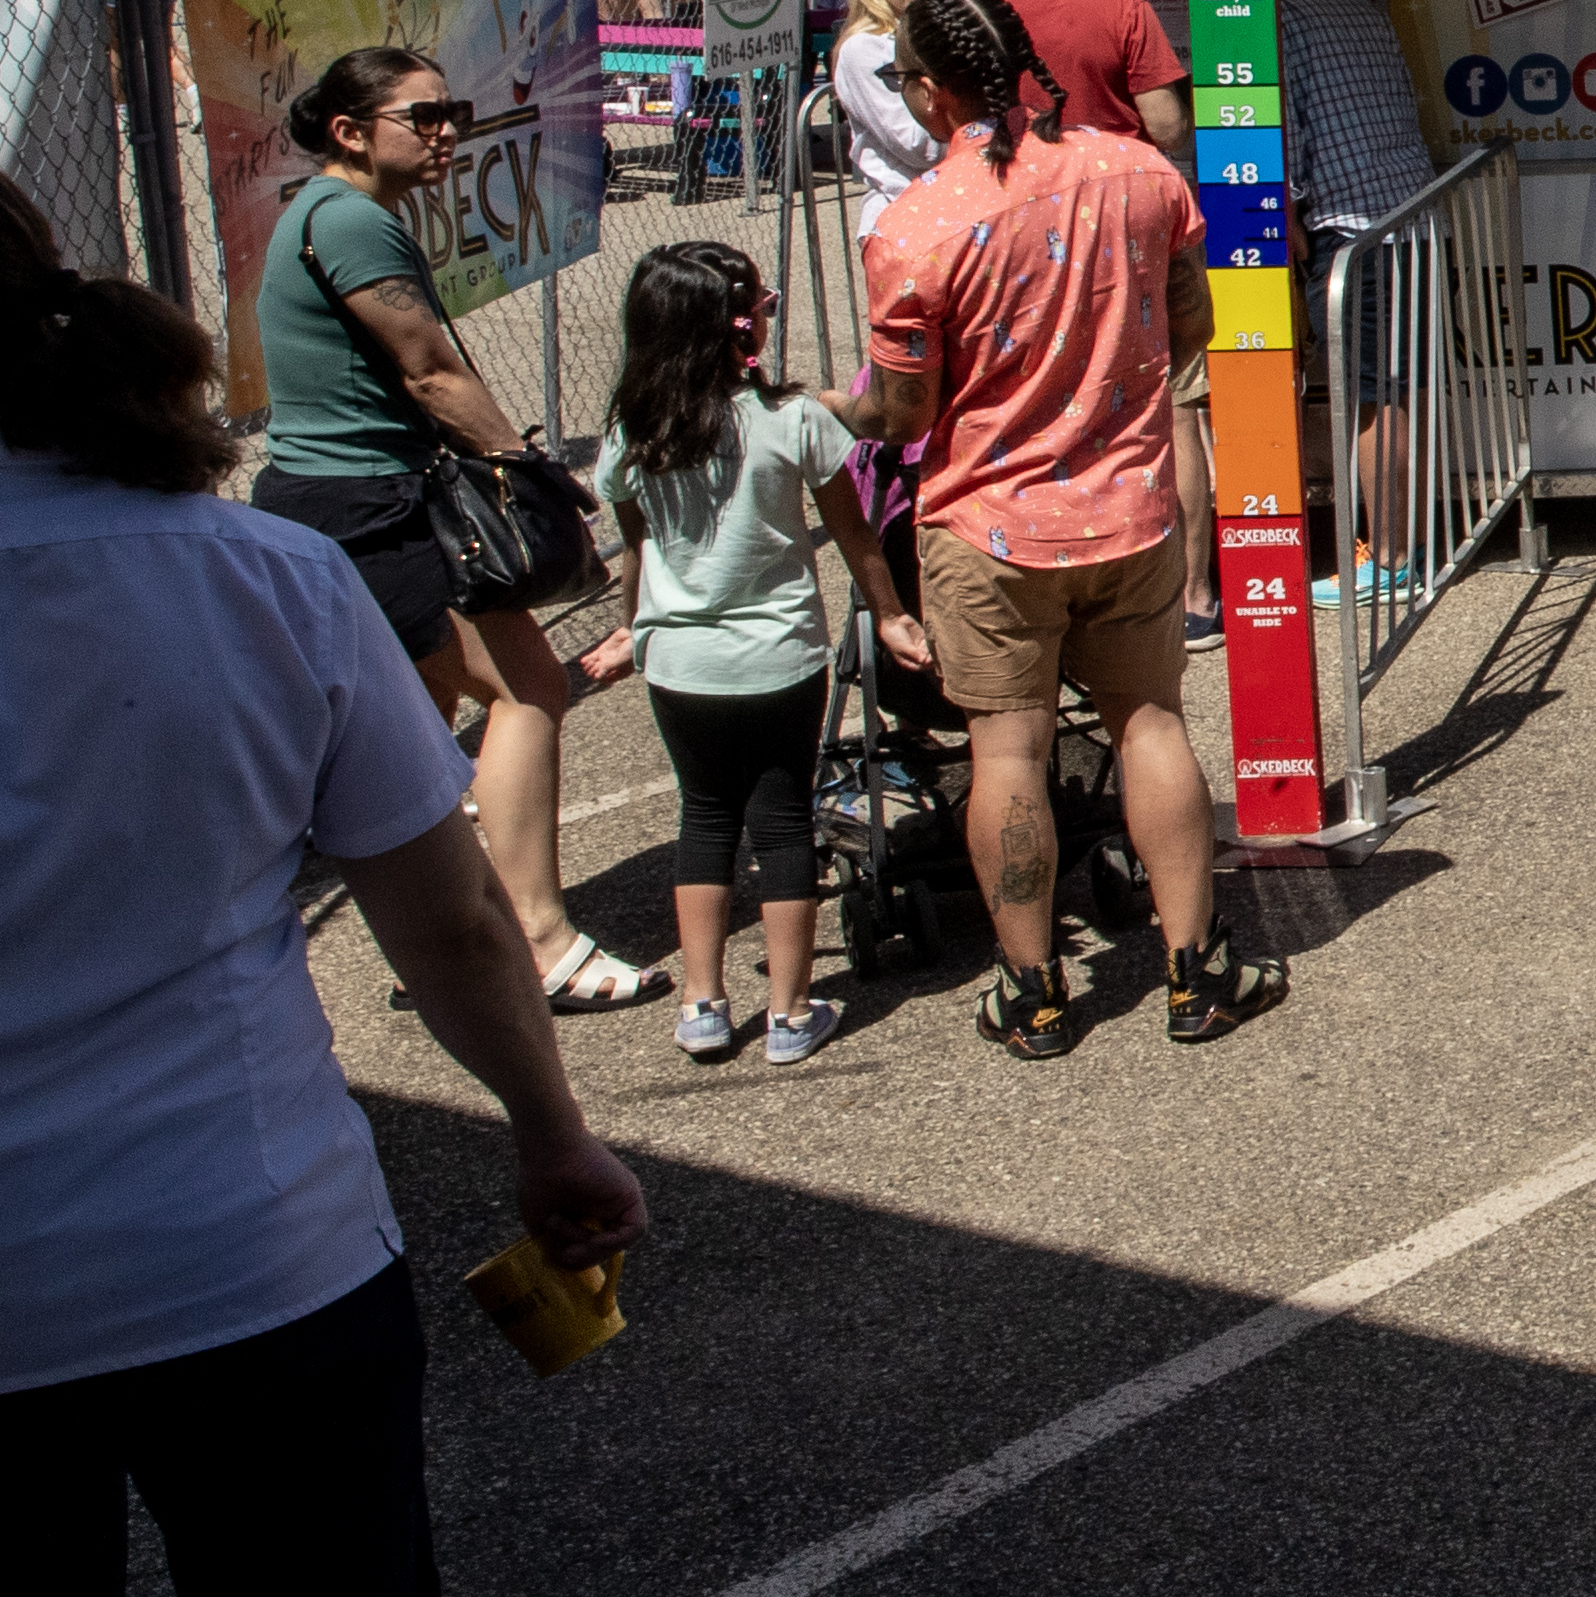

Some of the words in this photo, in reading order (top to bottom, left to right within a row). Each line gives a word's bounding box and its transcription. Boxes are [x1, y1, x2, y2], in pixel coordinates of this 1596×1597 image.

[1215, 4, 1252, 18] child
[711, 29, 794, 69] 616-454-1911
[259, 48, 299, 116] FUN
[1216, 62, 1254, 85] 55
[1218, 104, 1257, 128] 52
[1221, 162, 1260, 185] 48
[1260, 197, 1279, 210] 46
[1261, 227, 1280, 240] 44
[1230, 247, 1262, 268] 42
[1233, 331, 1266, 351] 36
[1241, 494, 1280, 516] 24
[1236, 527, 1301, 546] SKERBECK
[1246, 577, 1287, 601] 24
[1235, 606, 1281, 617] UNABLE
[1282, 606, 1298, 616] TO
[1252, 617, 1282, 628] RIDE
[1251, 759, 1317, 777] SKERBECK
